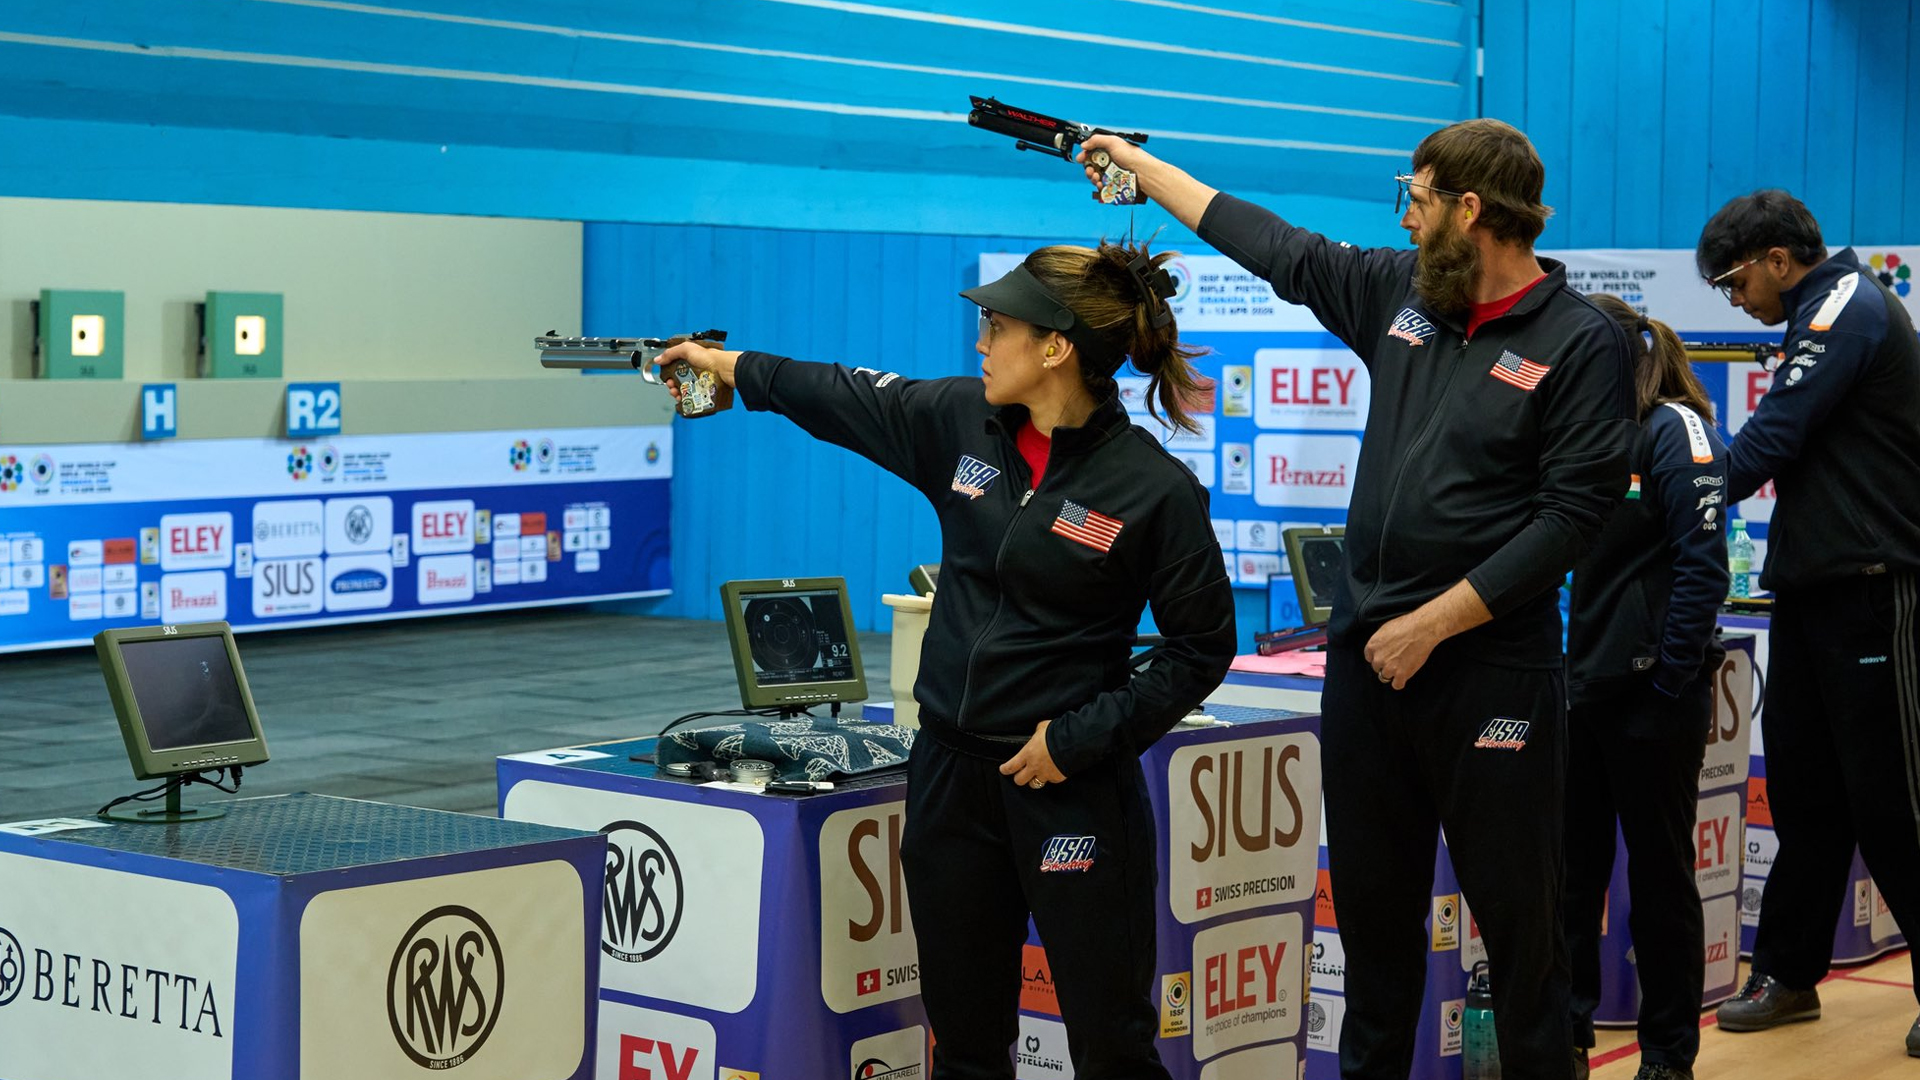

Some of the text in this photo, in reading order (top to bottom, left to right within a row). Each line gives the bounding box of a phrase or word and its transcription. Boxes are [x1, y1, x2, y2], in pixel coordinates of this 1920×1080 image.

[1007, 110, 1057, 128] WALTHER
[1567, 271, 1656, 280] SSF WORLD CUP
[1603, 283, 1641, 292] PISTOL
[1392, 308, 1437, 338] USA
[1271, 368, 1356, 405] ELEY
[144, 390, 175, 431] H
[288, 389, 339, 430] R2
[953, 455, 1001, 488] USA
[1269, 455, 1346, 487] Perazzi
[171, 526, 224, 554] ELEY
[422, 512, 468, 539] ELEY
[263, 562, 314, 599] SIUS
[782, 579, 796, 588] SIUS
[171, 587, 218, 611] Perazzi
[162, 626, 178, 635] SIUS
[831, 644, 848, 657] 9.2
[1478, 718, 1530, 742] USA
[1701, 762, 1735, 781] PRECISION
[1190, 744, 1303, 863] SIUS
[1042, 836, 1096, 865] USA
[1695, 815, 1730, 871] EY
[848, 813, 902, 942] SI
[1214, 875, 1295, 902] SWISS PRECISION
[611, 949, 628, 961] SINCE
[32, 948, 223, 1038] BERETTA
[405, 930, 487, 1055] RWS
[1205, 941, 1288, 1021] ELEY
[1169, 1008, 1185, 1017] ISSF
[1205, 1007, 1287, 1036] the choice of champions
[430, 1054, 464, 1069] SINCE 1886
[619, 1034, 699, 1080] EY
